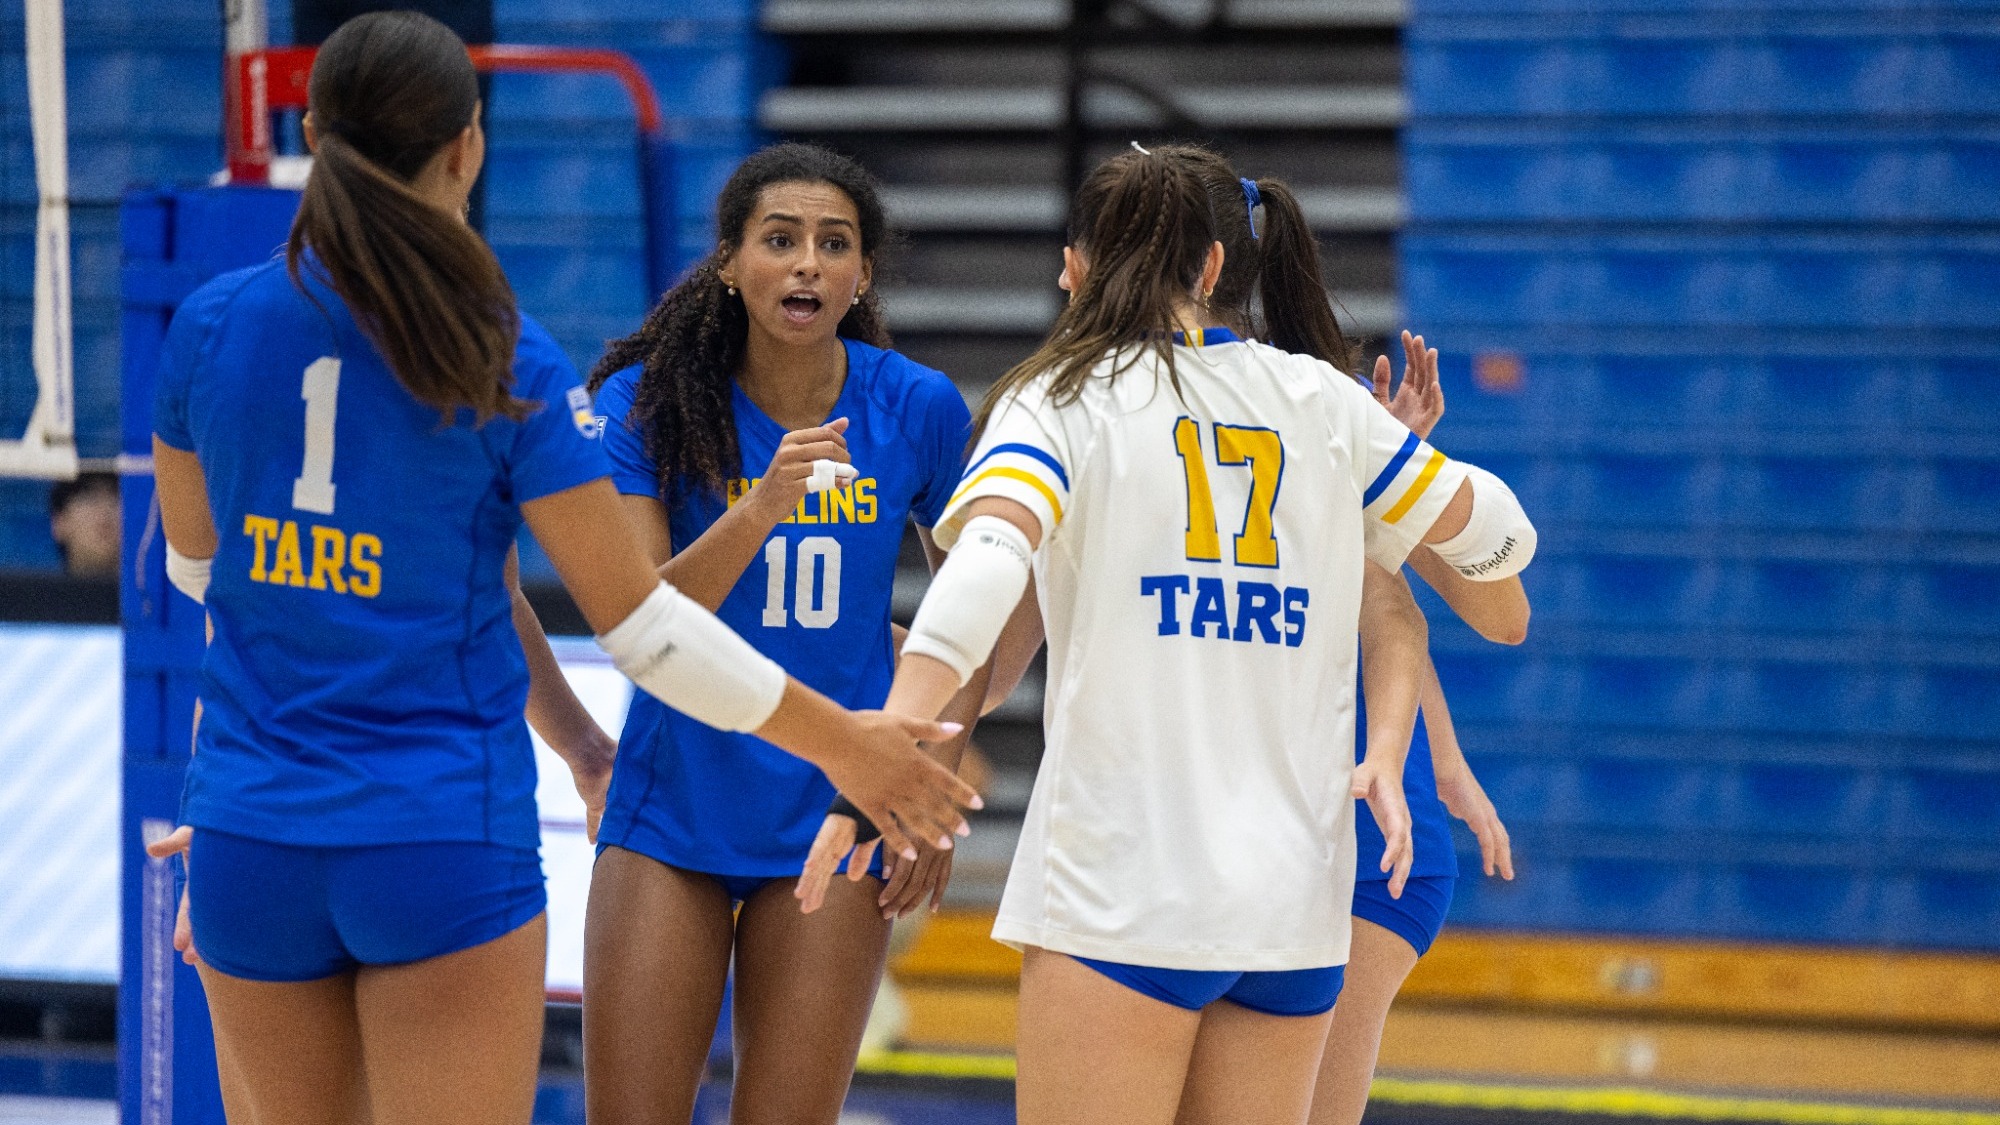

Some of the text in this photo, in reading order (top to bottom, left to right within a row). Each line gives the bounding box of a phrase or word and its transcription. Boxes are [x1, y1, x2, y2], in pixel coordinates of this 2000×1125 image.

[292, 356, 342, 515] 1
[727, 477, 878, 524] LINS
[1173, 416, 1285, 569] 17
[243, 513, 383, 598] TARS
[762, 536, 842, 629] 10
[1471, 536, 1518, 576] Tandem
[1140, 575, 1310, 648] TARS
